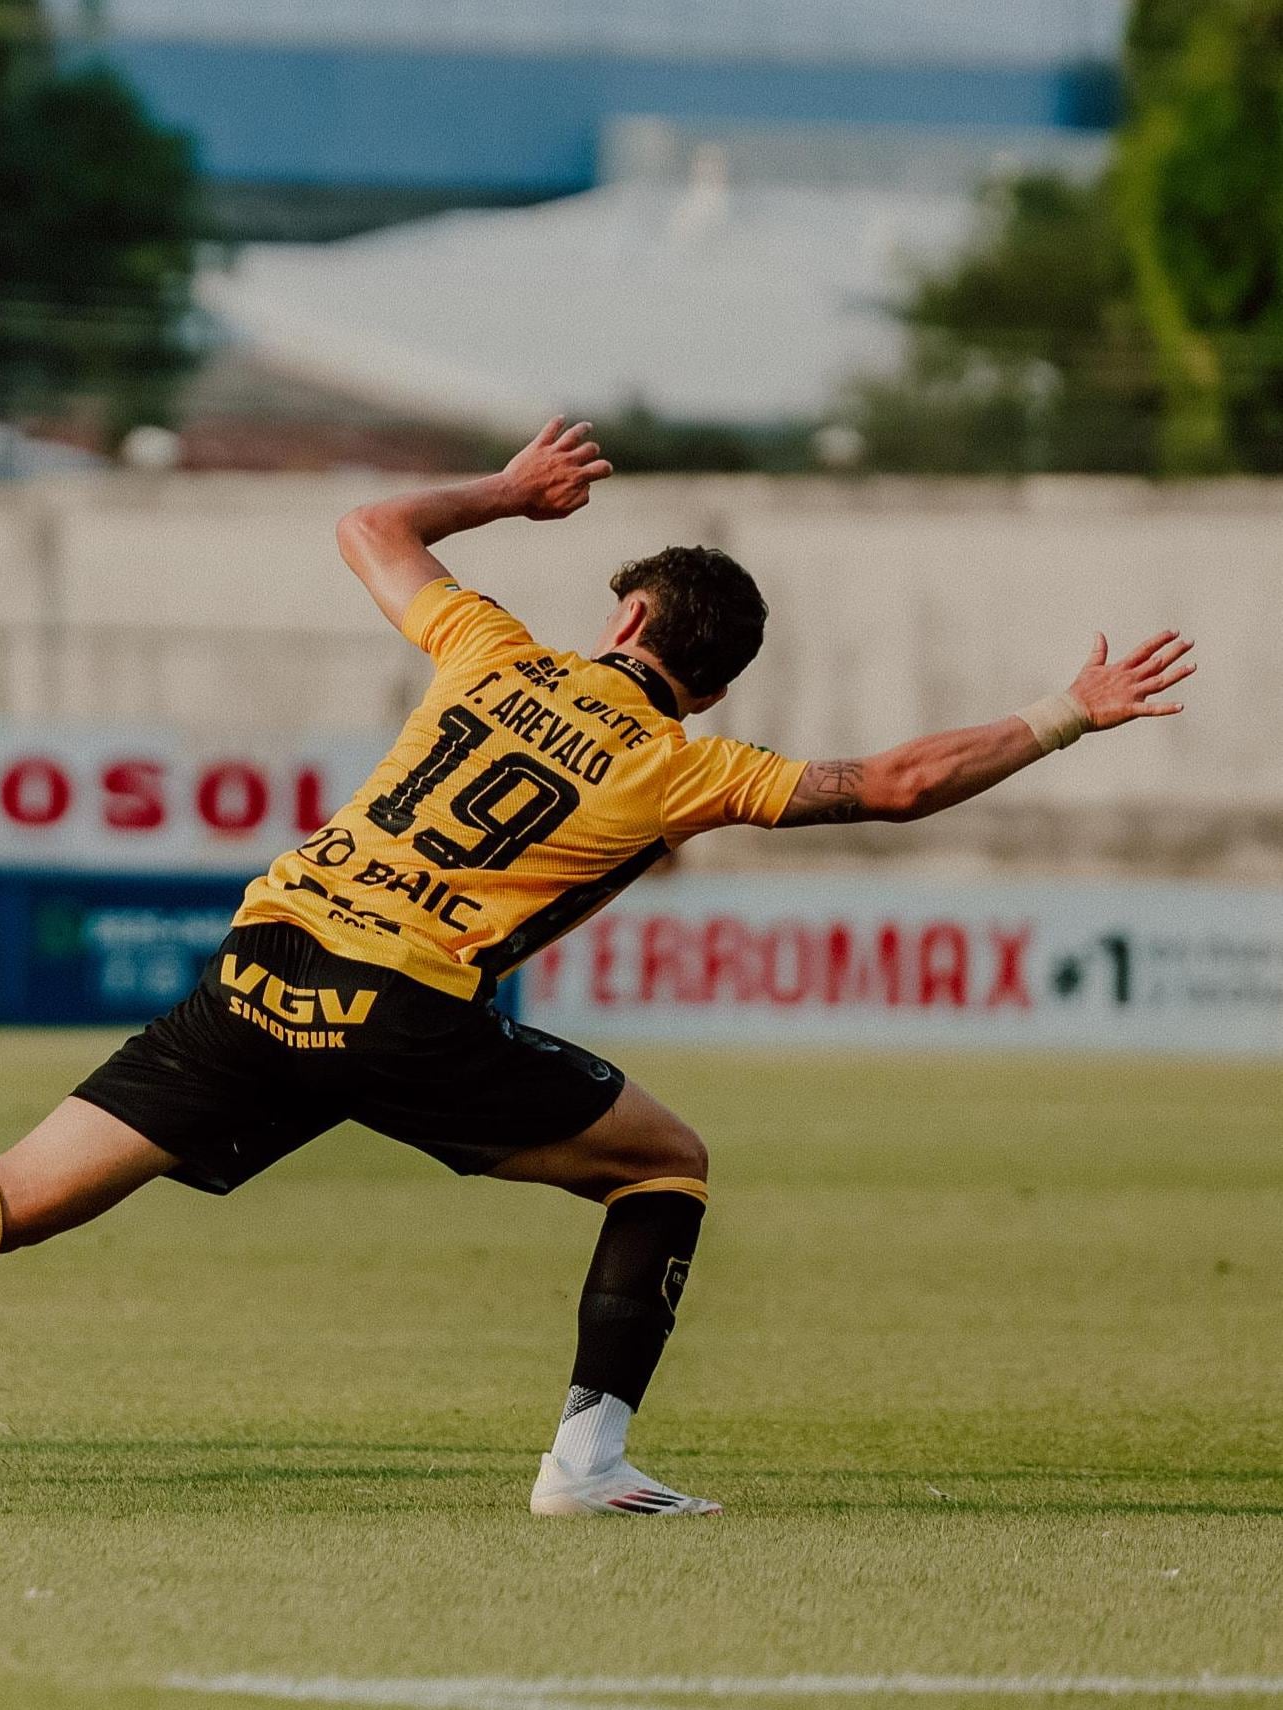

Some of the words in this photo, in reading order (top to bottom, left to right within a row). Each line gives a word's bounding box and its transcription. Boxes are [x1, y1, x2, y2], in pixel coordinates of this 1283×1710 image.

[487, 688, 615, 786] AREVALO
[365, 703, 581, 872] 19
[352, 858, 484, 933] BAIC
[220, 953, 379, 1025] VGV
[229, 995, 346, 1049] SINOTRUK
